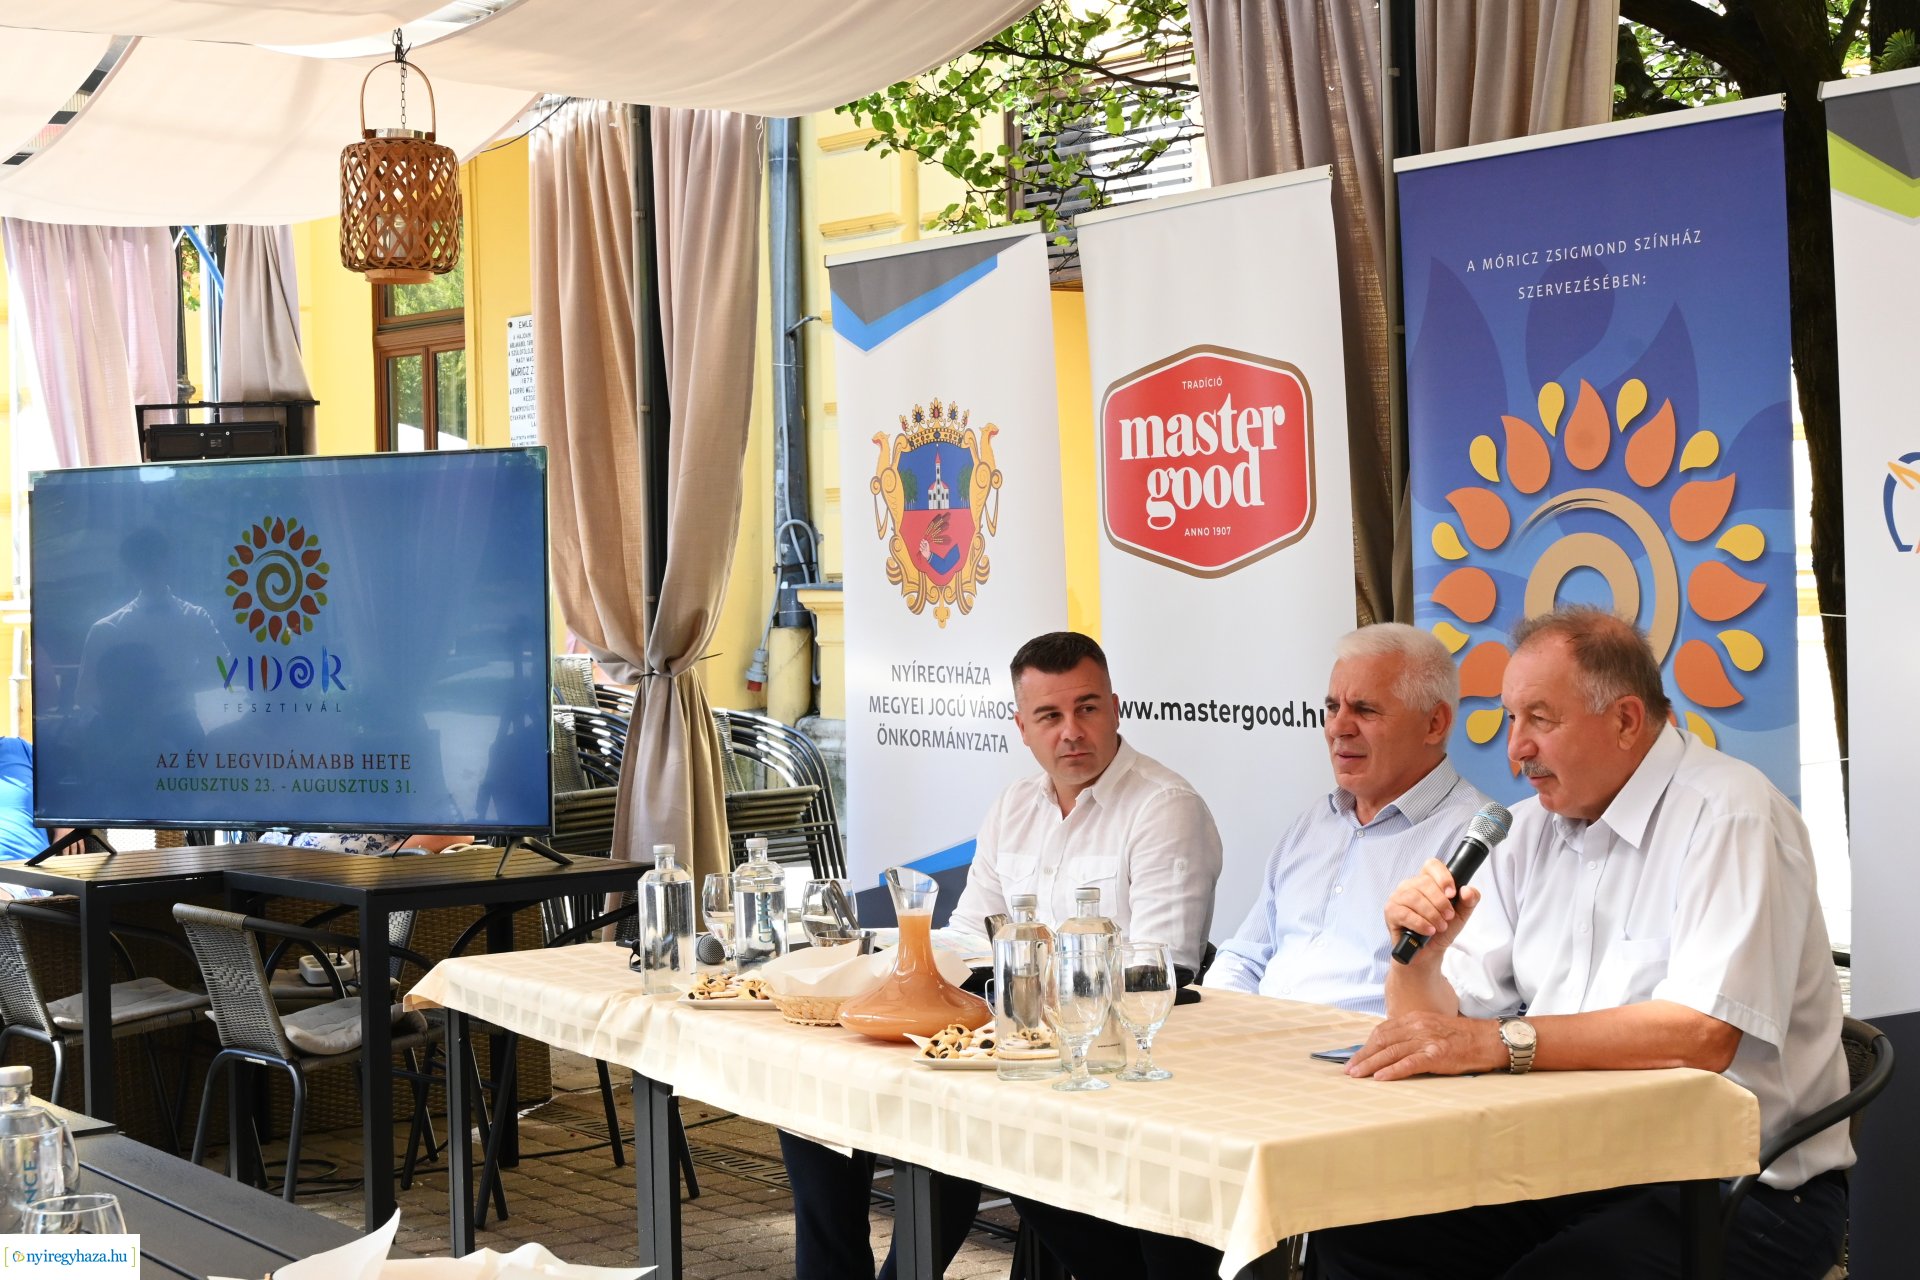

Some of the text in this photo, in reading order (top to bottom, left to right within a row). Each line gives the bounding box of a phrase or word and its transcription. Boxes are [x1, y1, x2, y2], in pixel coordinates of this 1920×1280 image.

[1466, 229, 1701, 272] A MÓRICZ ZSIGMOND SZÍNHÁZ
[1518, 273, 1647, 299] SZERVEZÉSÉBEN:
[1182, 376, 1223, 390] TRADÍCIÓ
[1119, 393, 1286, 461] master
[1146, 447, 1265, 531] good
[1184, 526, 1232, 537] ANNO 1907
[216, 646, 347, 693] VIDOR
[891, 660, 991, 686] NYÍREGYHÁZA
[223, 702, 342, 713] FESZTIVÁL
[869, 694, 1015, 721] MEGYEI JOGÚ VÁROS
[877, 723, 1009, 754] ÖNKORMÁNYZATA
[156, 749, 411, 770] AZ ÉV LEGVIDÁMABB HETE
[155, 777, 249, 792] AUGUSZTUS
[254, 778, 275, 793] 23.
[291, 779, 390, 794] AUGUSZTUS
[395, 780, 417, 794] 31.
